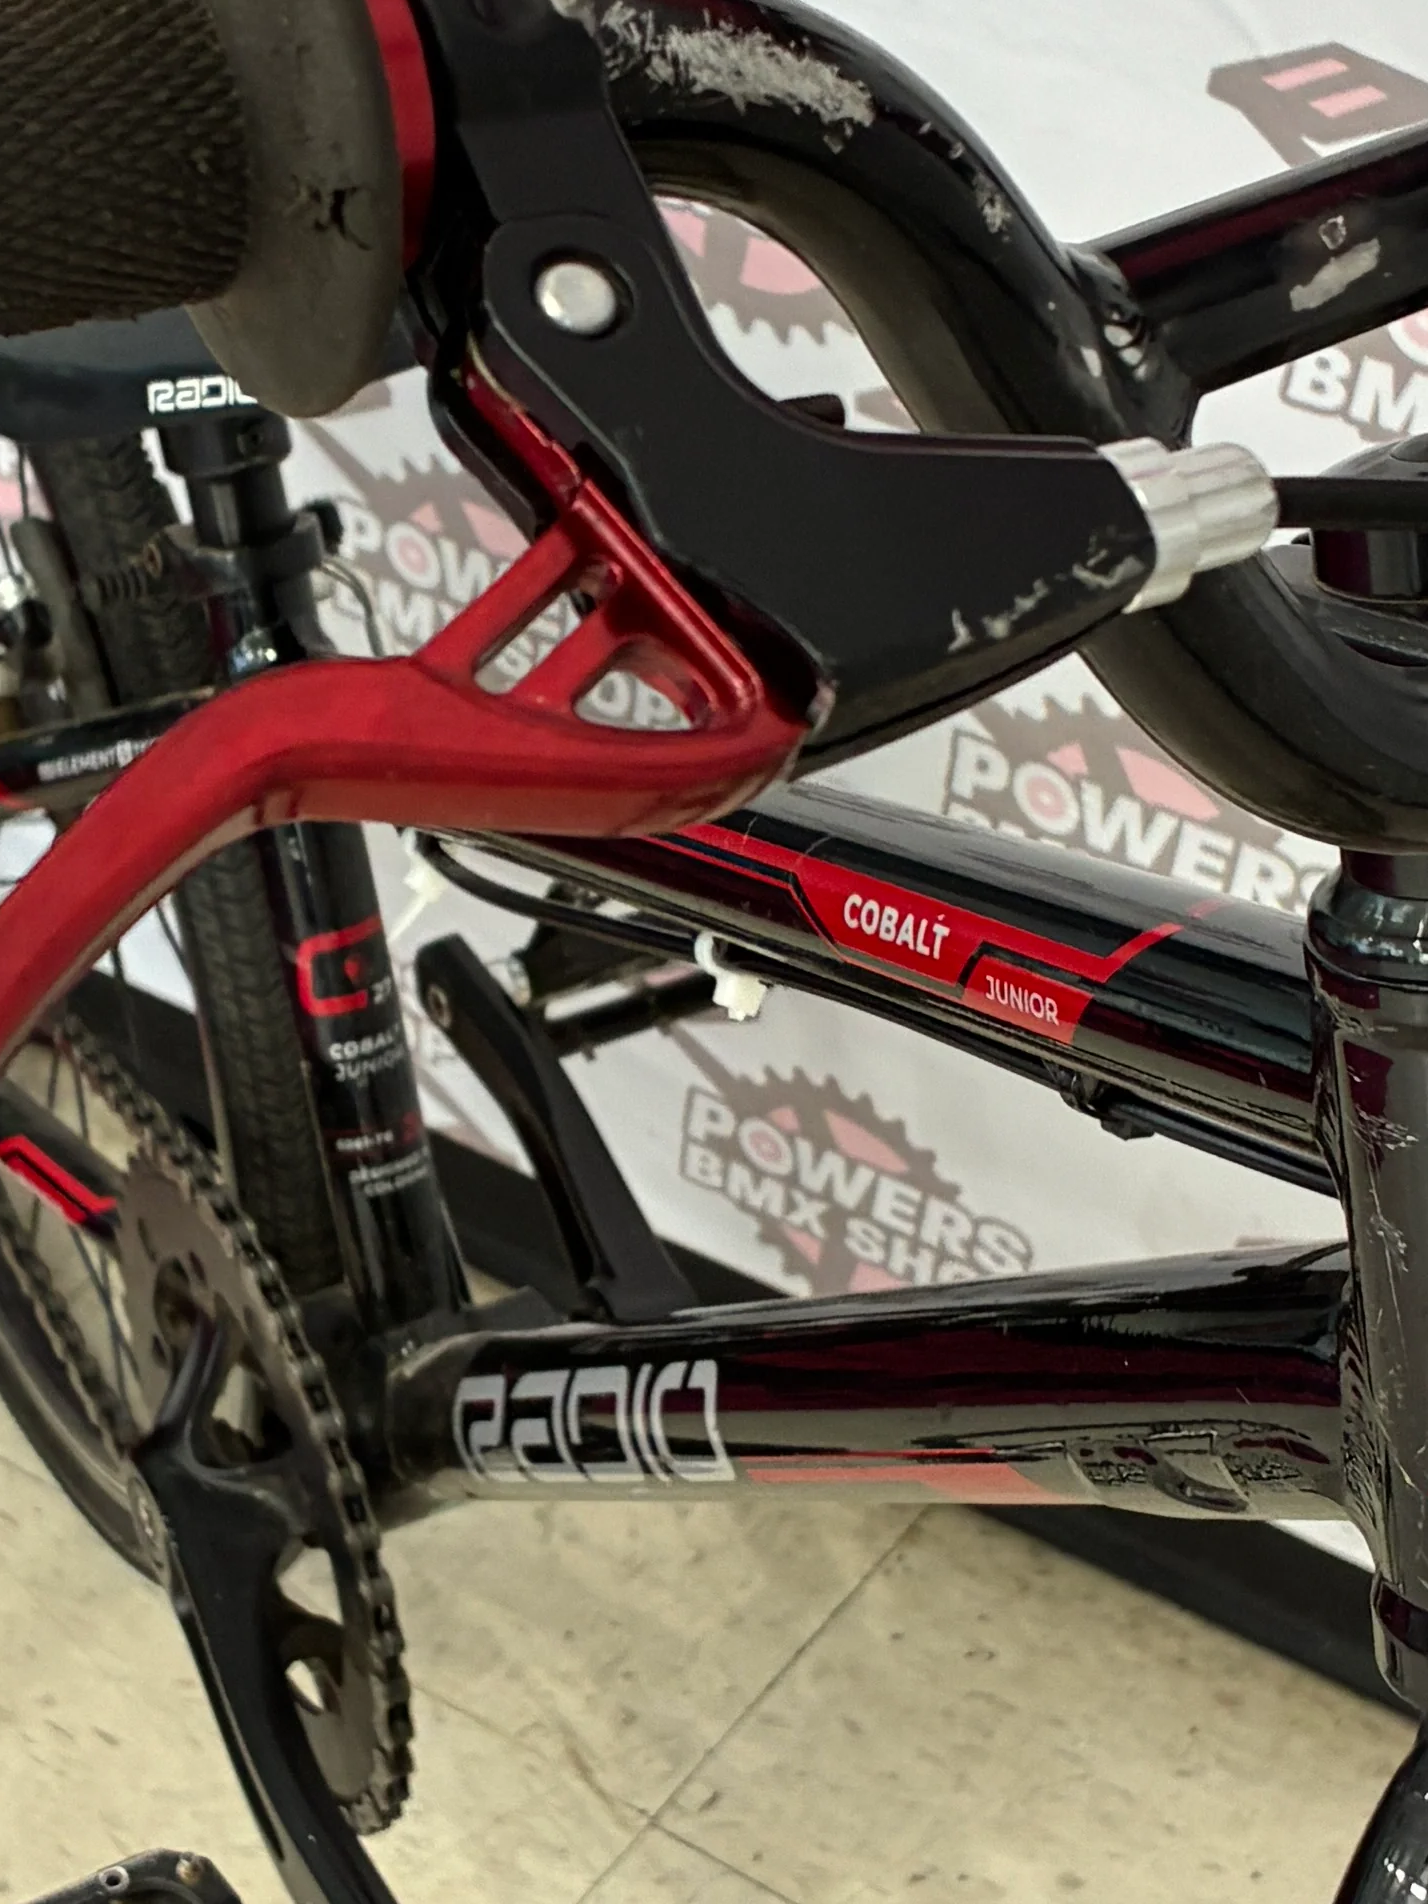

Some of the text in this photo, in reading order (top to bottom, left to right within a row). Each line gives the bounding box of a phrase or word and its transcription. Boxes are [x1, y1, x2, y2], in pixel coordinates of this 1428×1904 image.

[951, 735, 1329, 915] POWER
[843, 893, 950, 960] COBALT
[985, 974, 1059, 1026] JUNIOR
[685, 1144, 978, 1286] BMX SH
[688, 1092, 1028, 1274] POWERS
